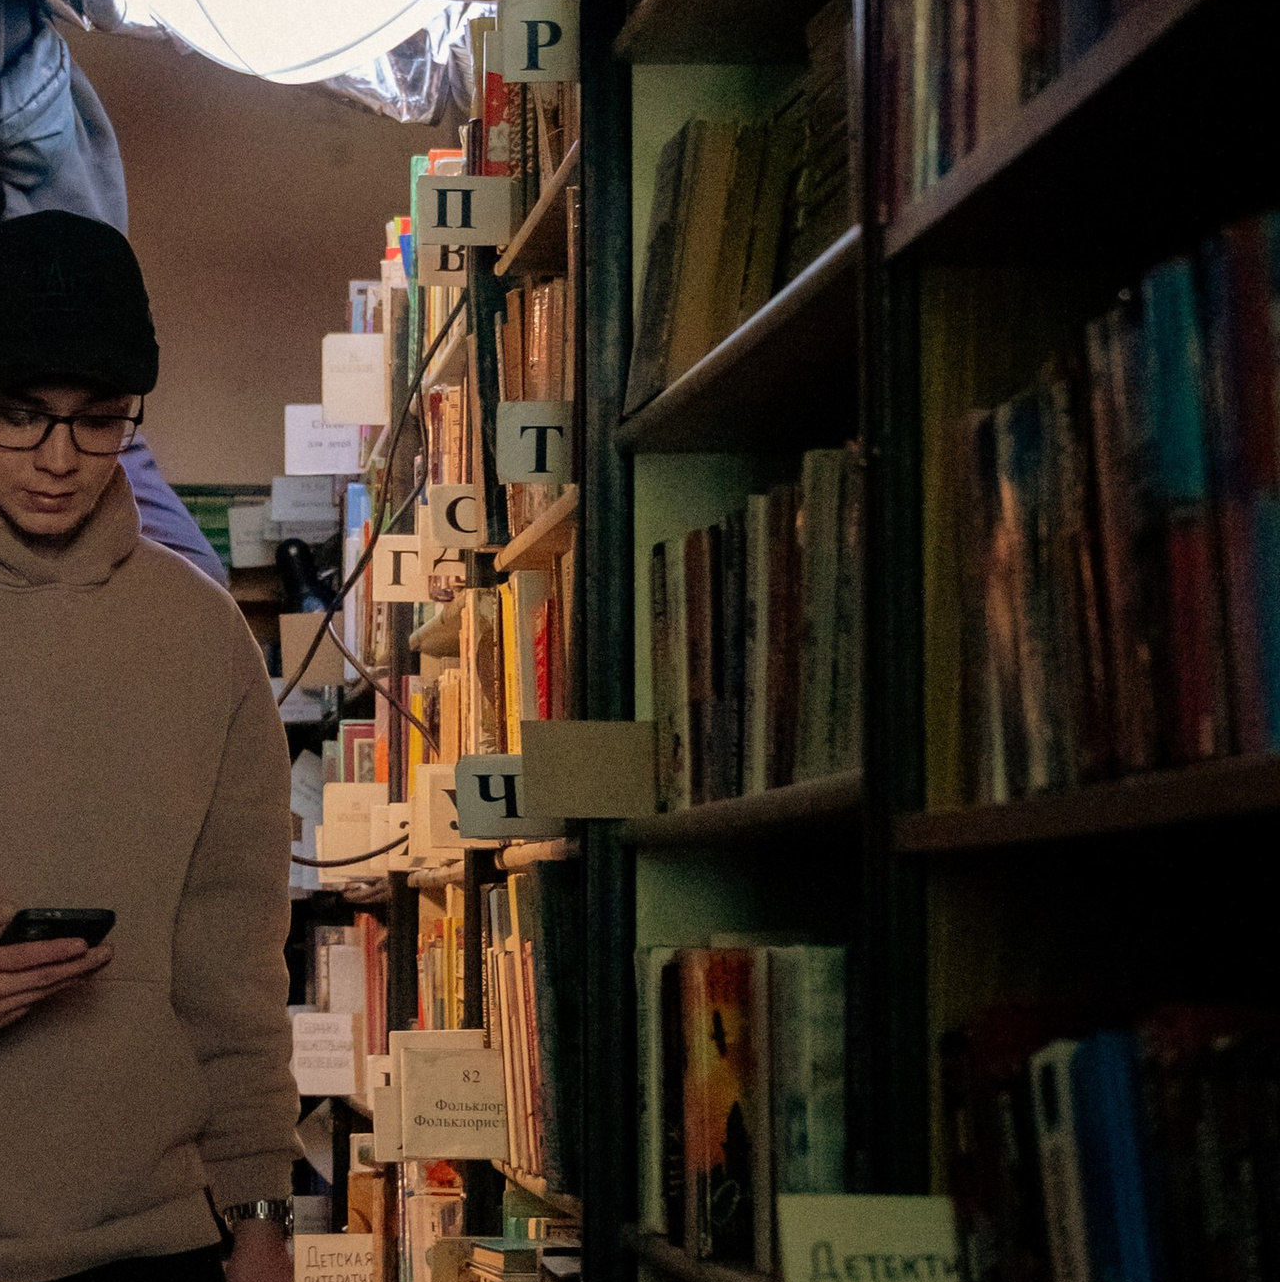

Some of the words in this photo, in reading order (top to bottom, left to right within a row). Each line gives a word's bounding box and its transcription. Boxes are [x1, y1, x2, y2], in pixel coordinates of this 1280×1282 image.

[520, 21, 562, 70] Р
[432, 189, 477, 228] П
[520, 426, 563, 473] Т
[462, 1070, 480, 1083] 82
